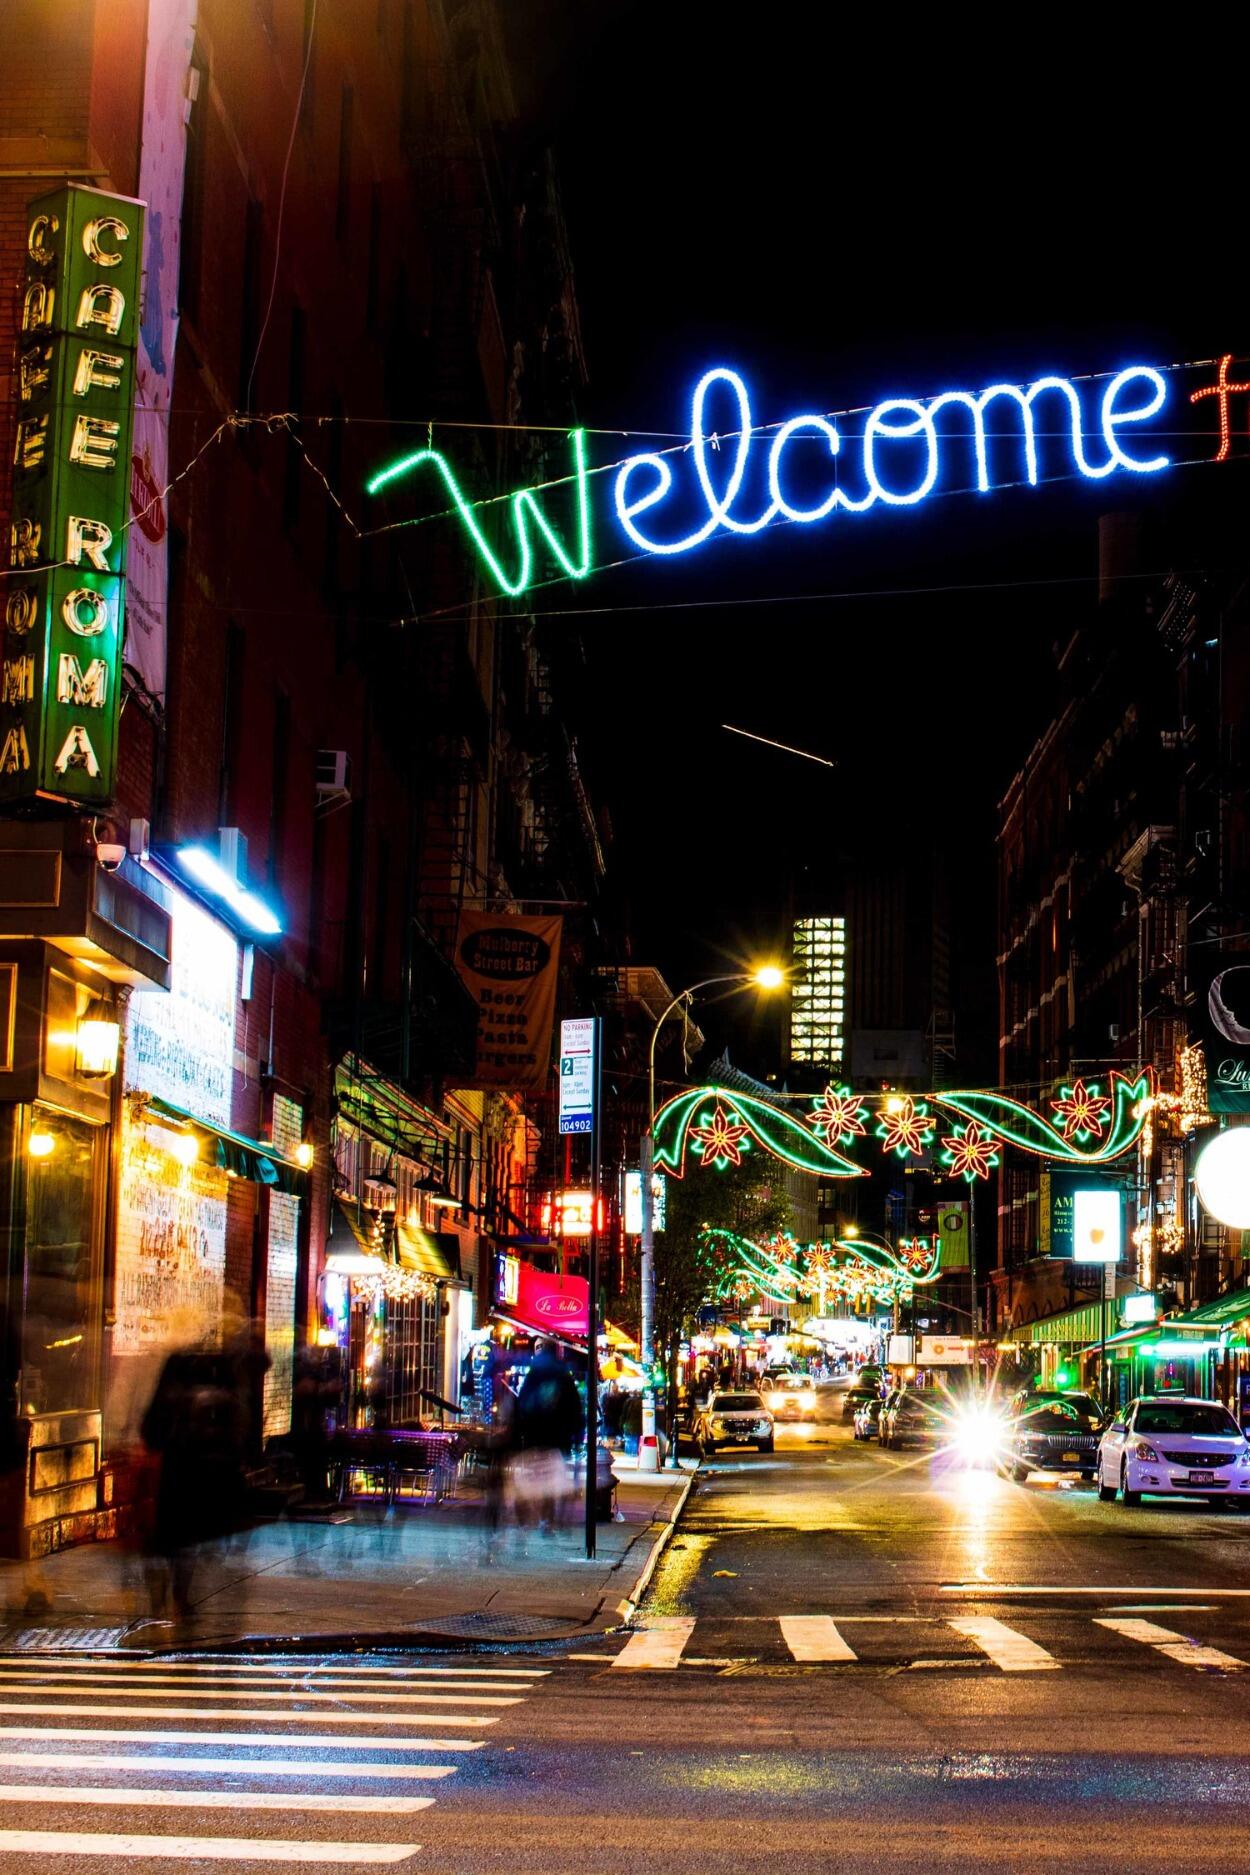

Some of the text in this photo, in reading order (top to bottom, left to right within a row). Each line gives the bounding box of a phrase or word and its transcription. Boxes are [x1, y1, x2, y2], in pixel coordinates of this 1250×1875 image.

[367, 366, 1170, 595] Welcome
[55, 216, 129, 777] CAFE ROMA
[478, 935, 540, 956] Mulberry
[472, 953, 539, 972] Street Bar
[480, 989, 525, 1006] Beer
[564, 1023, 592, 1032] NO PARKING
[564, 1059, 571, 1074] 2
[561, 1120, 591, 1131] 104902
